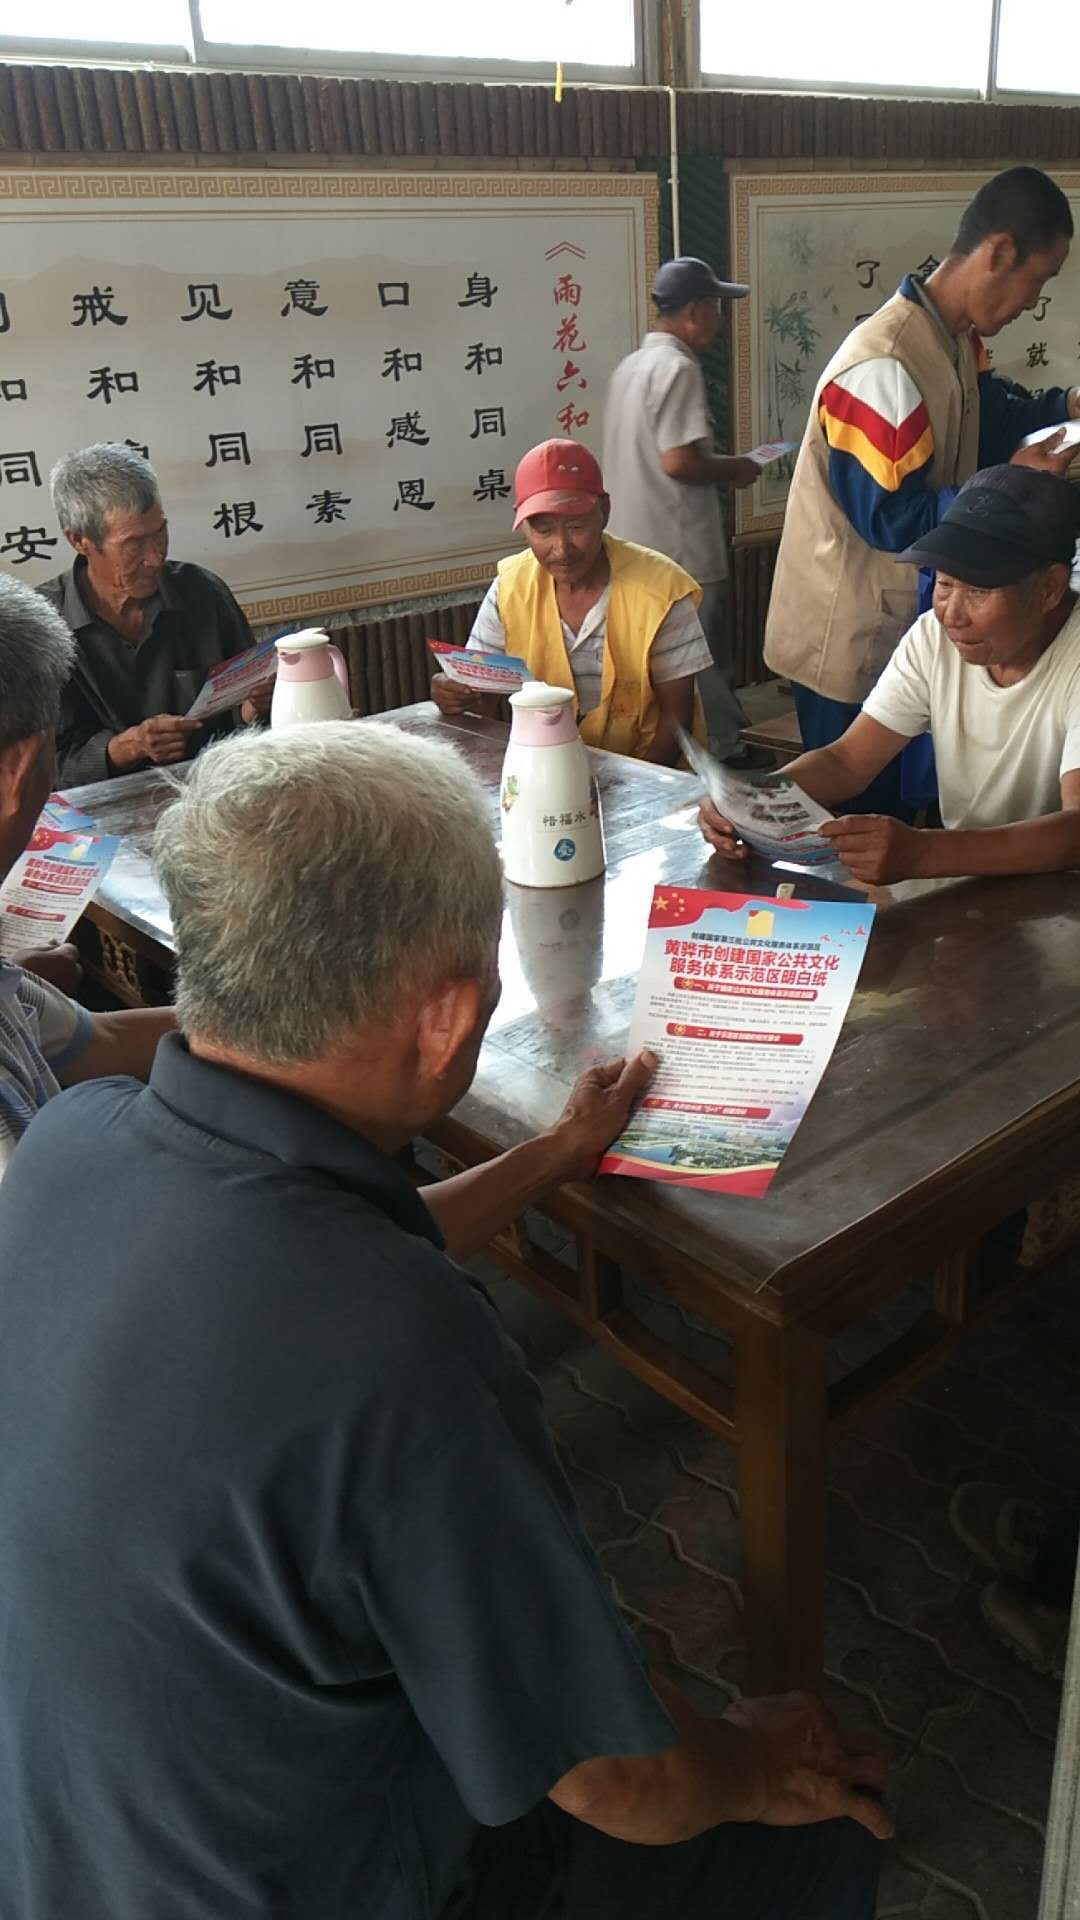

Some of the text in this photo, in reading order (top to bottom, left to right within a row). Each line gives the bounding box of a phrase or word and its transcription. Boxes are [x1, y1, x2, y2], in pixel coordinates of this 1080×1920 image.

[0, 292, 57, 564] 同安
[180, 283, 264, 538] 见和同根
[281, 279, 352, 524] 意和同素
[378, 280, 435, 511] 口和感恩
[457, 272, 512, 501] 身和同桌
[664, 938, 840, 971] 黄骅市创建国家公共文化
[669, 957, 829, 987] 服务体系示范区明白纸
